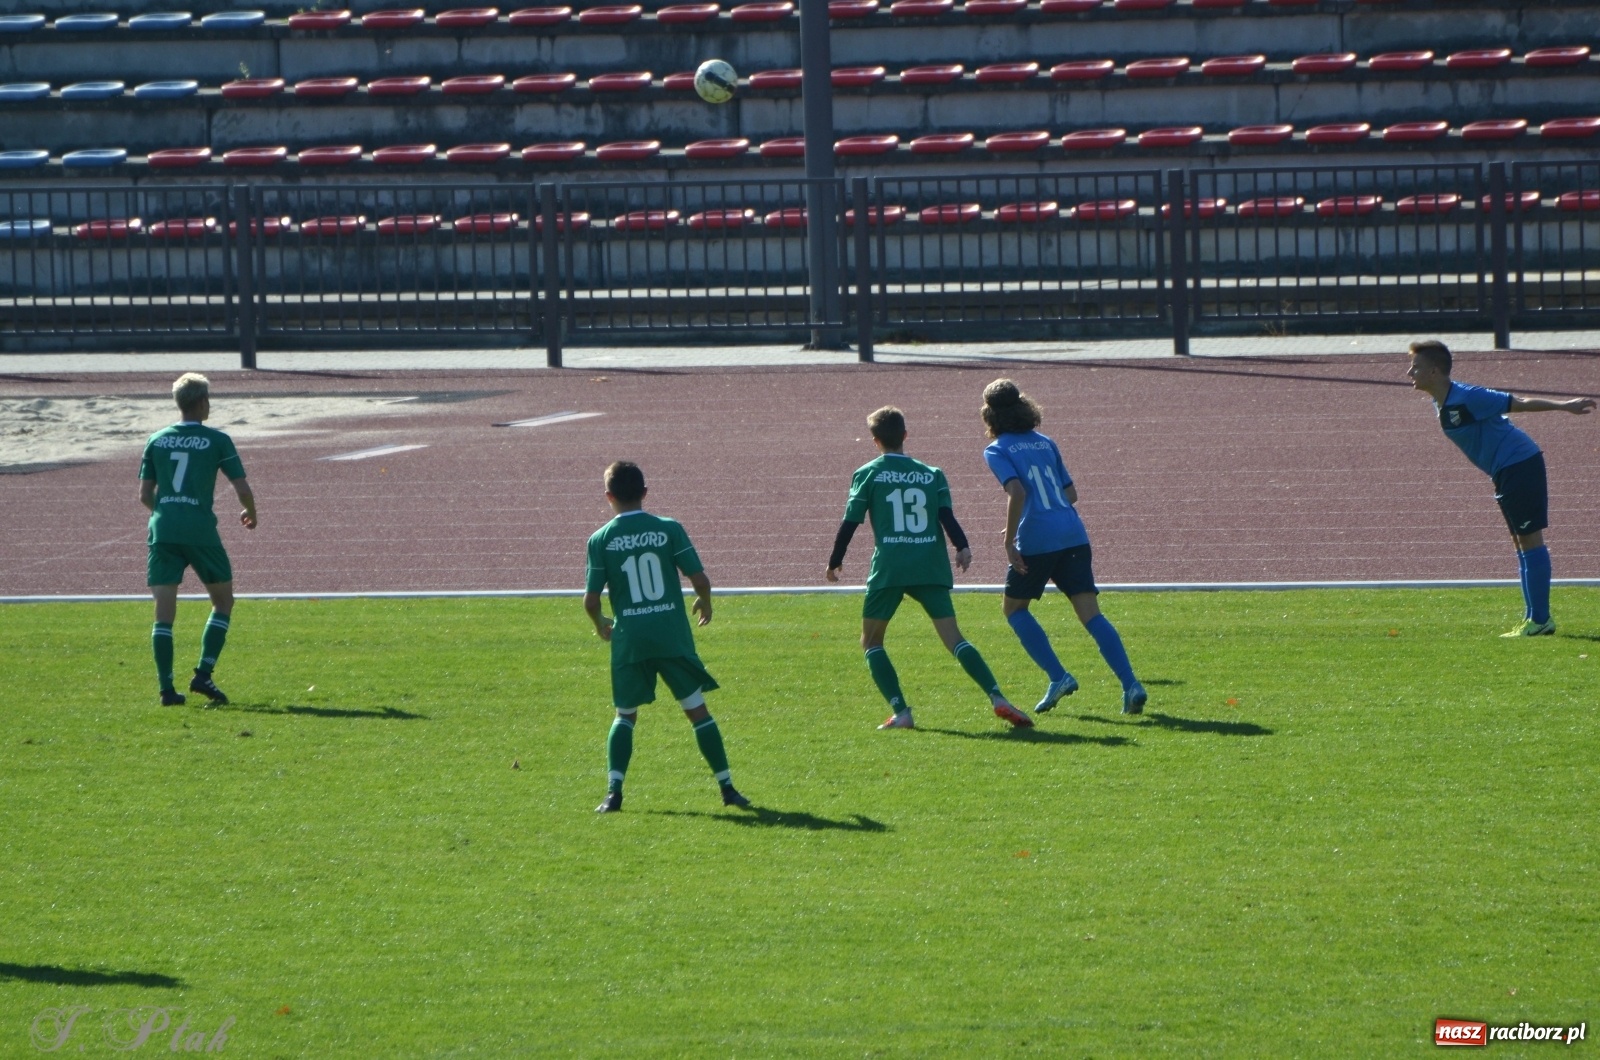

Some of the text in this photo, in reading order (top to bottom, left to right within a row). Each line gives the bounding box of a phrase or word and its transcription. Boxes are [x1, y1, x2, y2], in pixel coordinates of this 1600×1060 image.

[154, 436, 211, 449] REKORD
[170, 452, 189, 493] 7
[874, 470, 934, 485] REKORD
[1027, 465, 1068, 510] 11
[886, 488, 928, 533] 13
[606, 532, 668, 551] REKORD
[620, 552, 665, 603] 10
